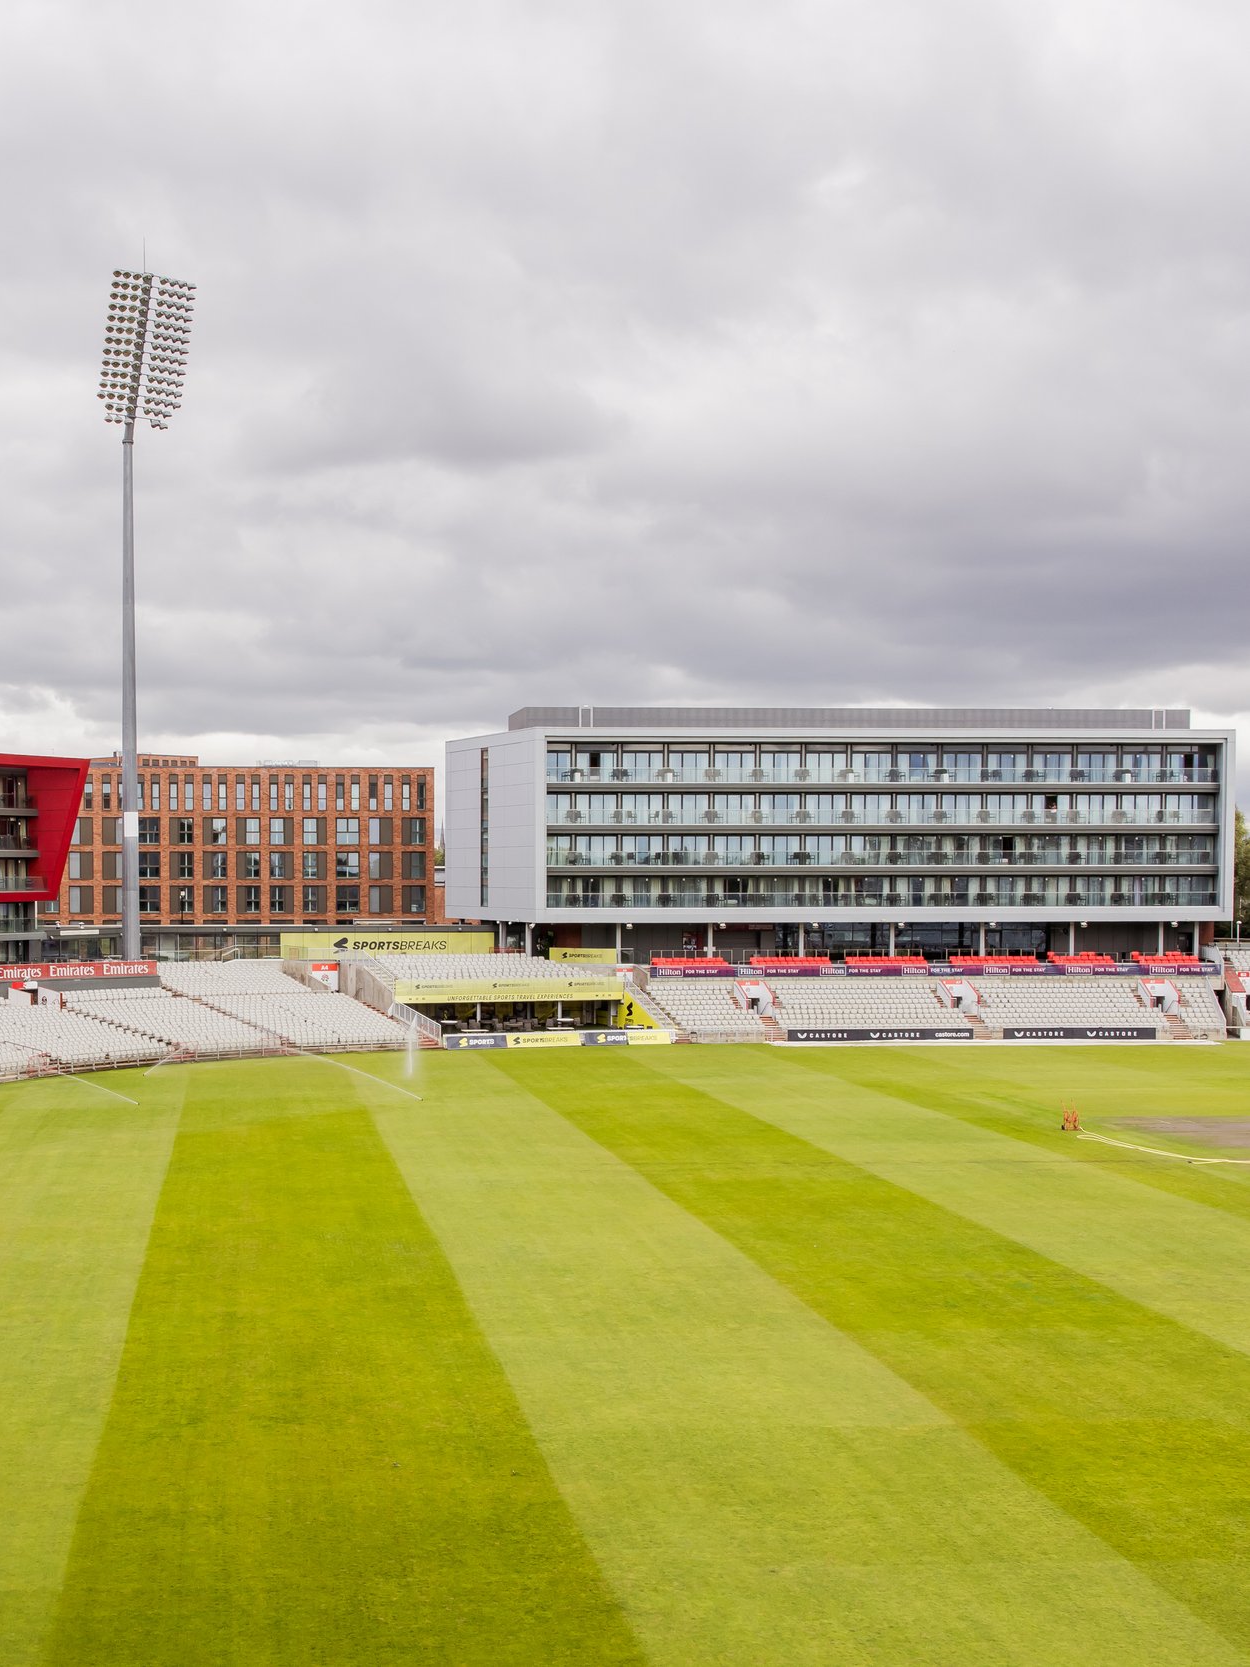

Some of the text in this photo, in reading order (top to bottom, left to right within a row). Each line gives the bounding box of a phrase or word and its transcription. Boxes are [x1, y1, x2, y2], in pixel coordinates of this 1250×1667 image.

[352, 940, 448, 951] SPORTSBREAKS
[49, 964, 95, 977] Emirates
[103, 962, 149, 975] Emirates
[659, 968, 682, 976] Hilton
[740, 967, 763, 975] Hilton
[821, 967, 844, 975] Hilton
[903, 966, 926, 974] Hilton
[985, 966, 1008, 974] Hilton
[1067, 966, 1091, 974] Hilton
[1151, 966, 1175, 974] Hilton
